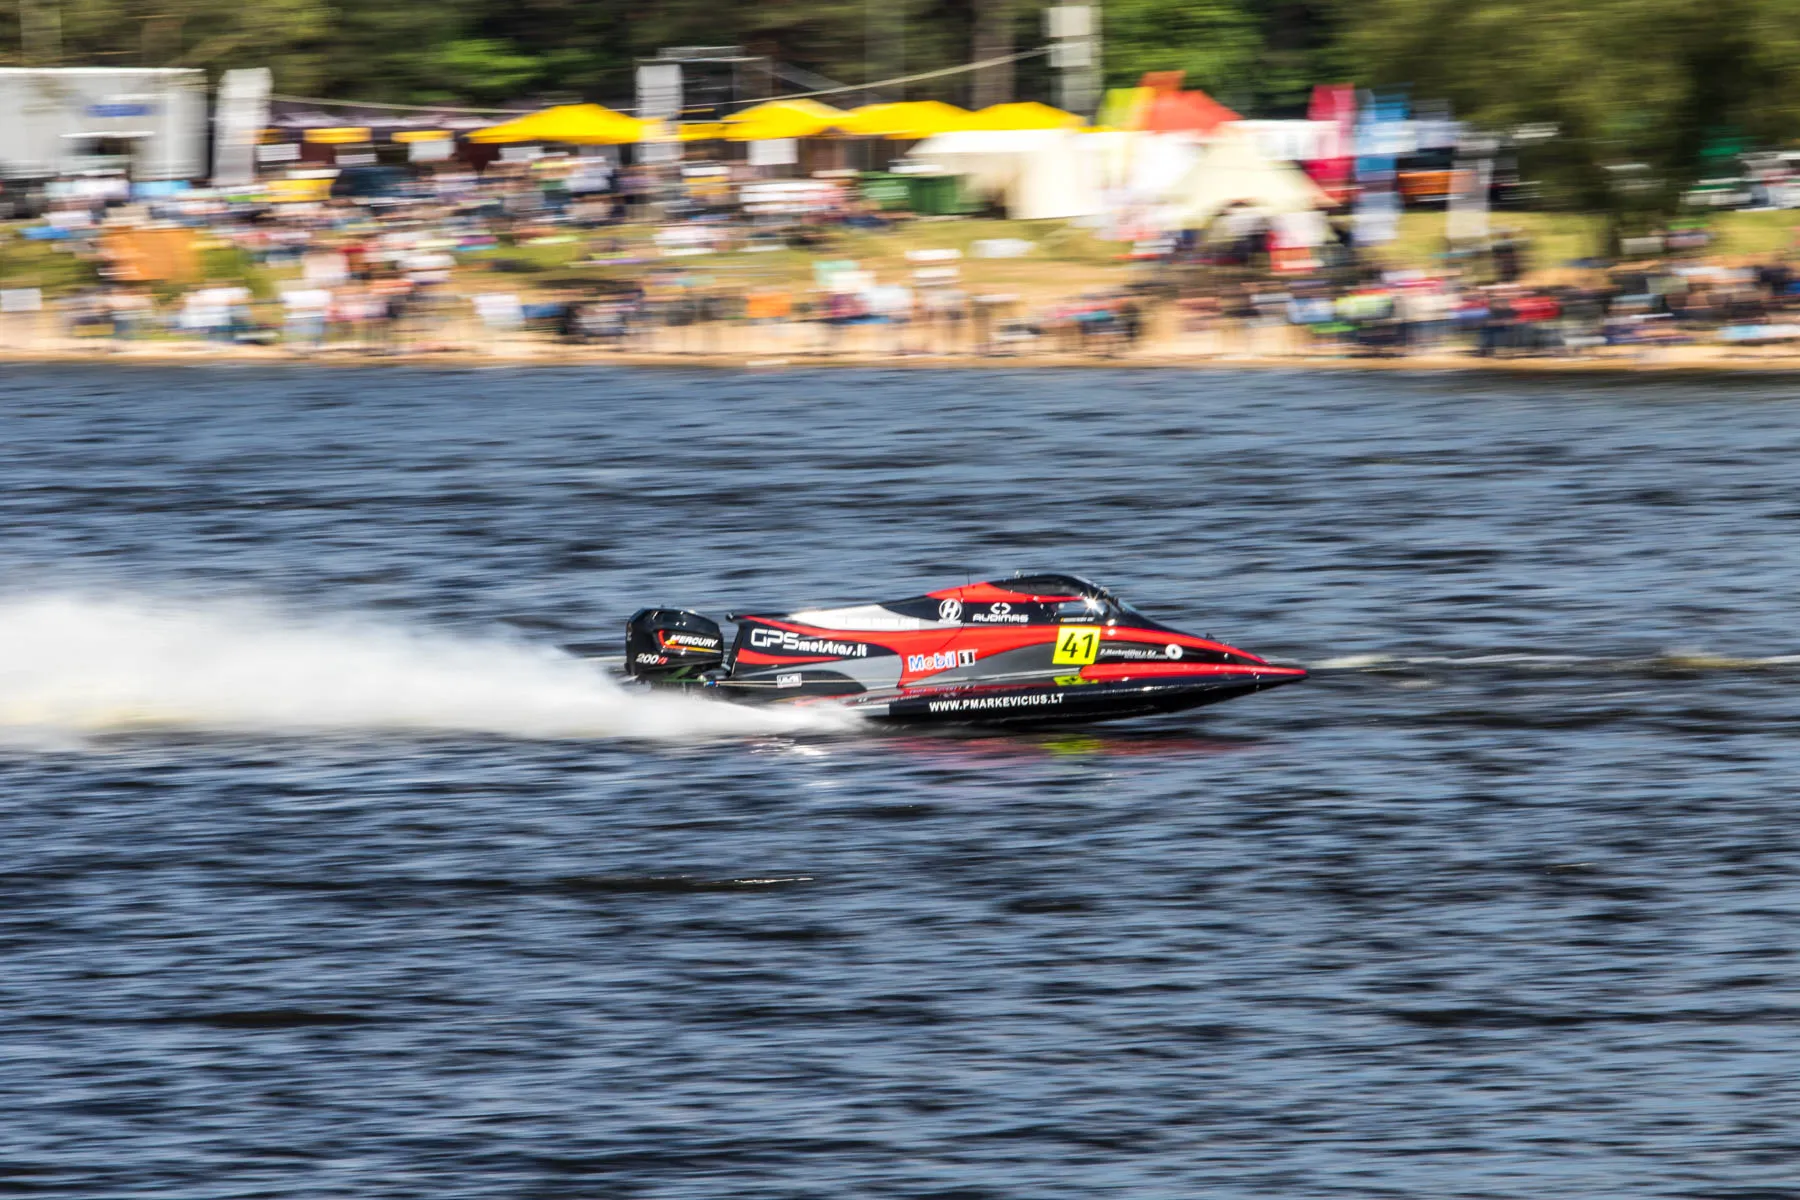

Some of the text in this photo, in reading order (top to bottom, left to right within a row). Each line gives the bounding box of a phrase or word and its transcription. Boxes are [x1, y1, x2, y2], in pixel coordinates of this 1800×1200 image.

[972, 613, 1029, 623] AUDIMAS
[669, 634, 718, 648] MERCURY
[1062, 632, 1094, 659] 41
[908, 651, 957, 672] Mobil
[929, 693, 1064, 713] WWW.PMARKEVICIUS.LT
